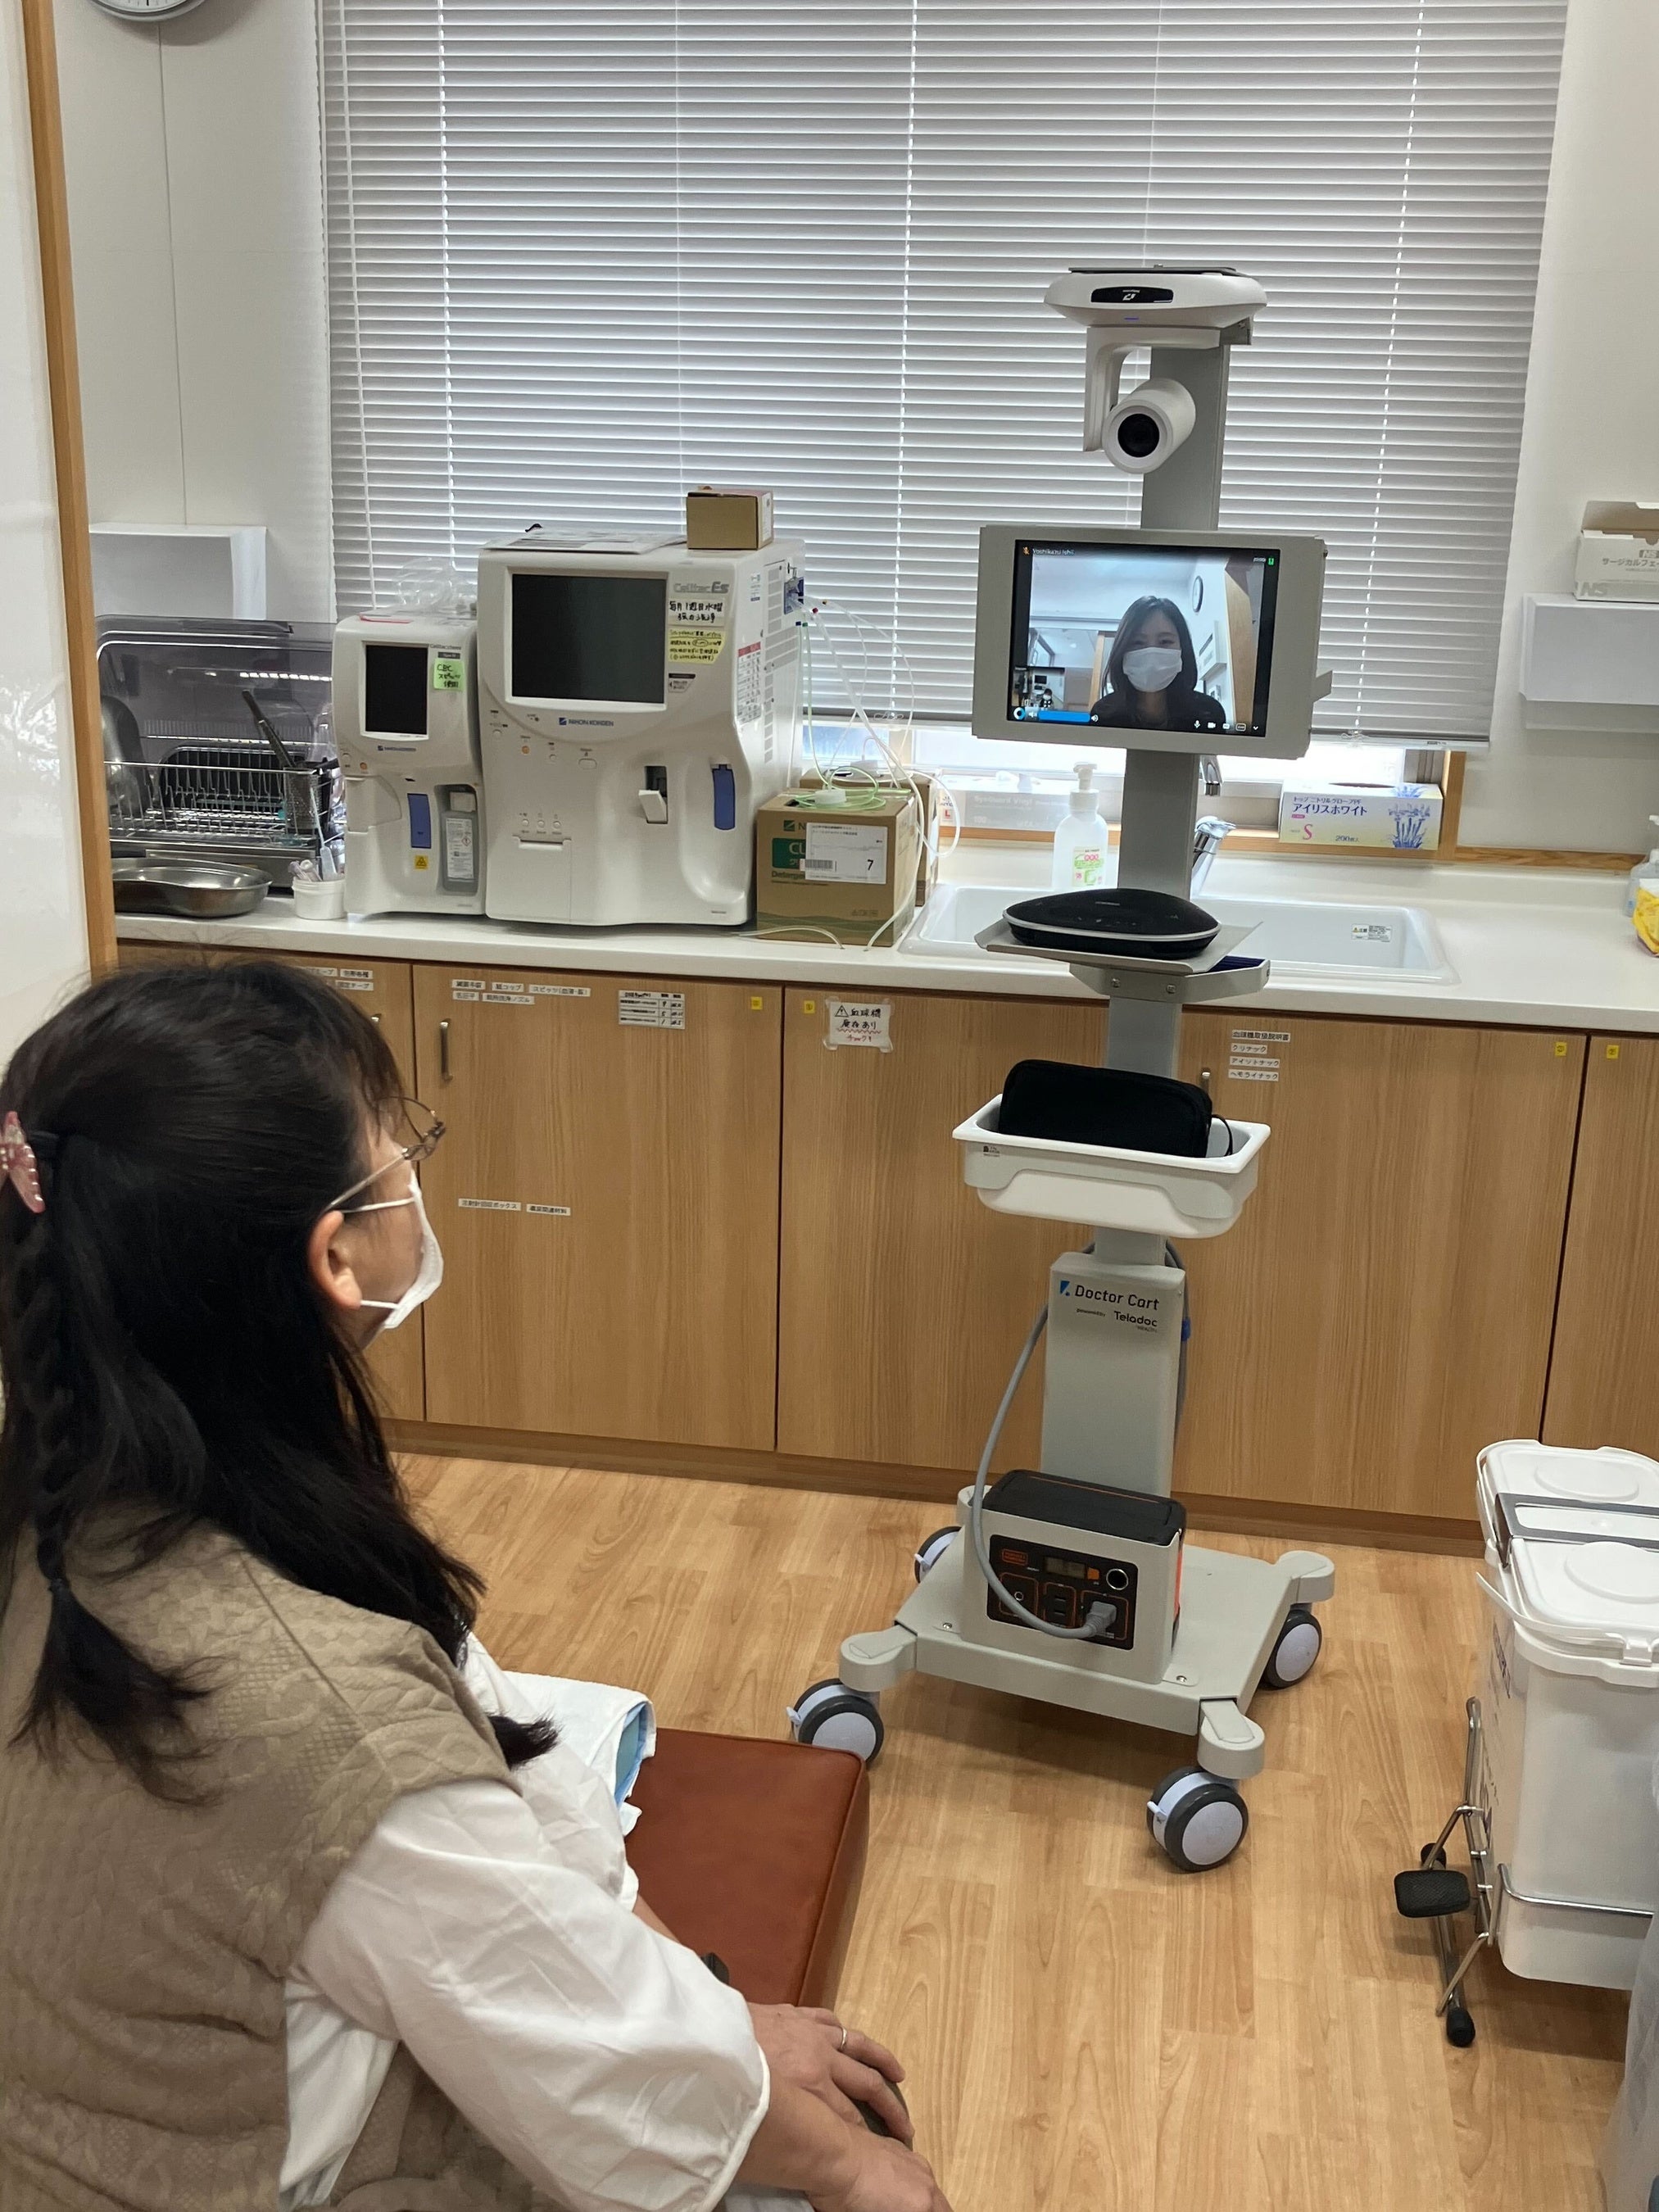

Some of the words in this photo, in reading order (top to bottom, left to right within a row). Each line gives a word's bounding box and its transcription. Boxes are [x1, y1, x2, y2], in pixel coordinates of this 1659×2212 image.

[437, 664, 454, 672] CBC
[1292, 804, 1367, 816] アイリスホワイト
[1303, 823, 1313, 841] S
[867, 859, 874, 871] 7
[1074, 1285, 1124, 1303] Doctor
[1127, 1294, 1159, 1311] Cart
[1113, 1310, 1158, 1327] Teladoc
